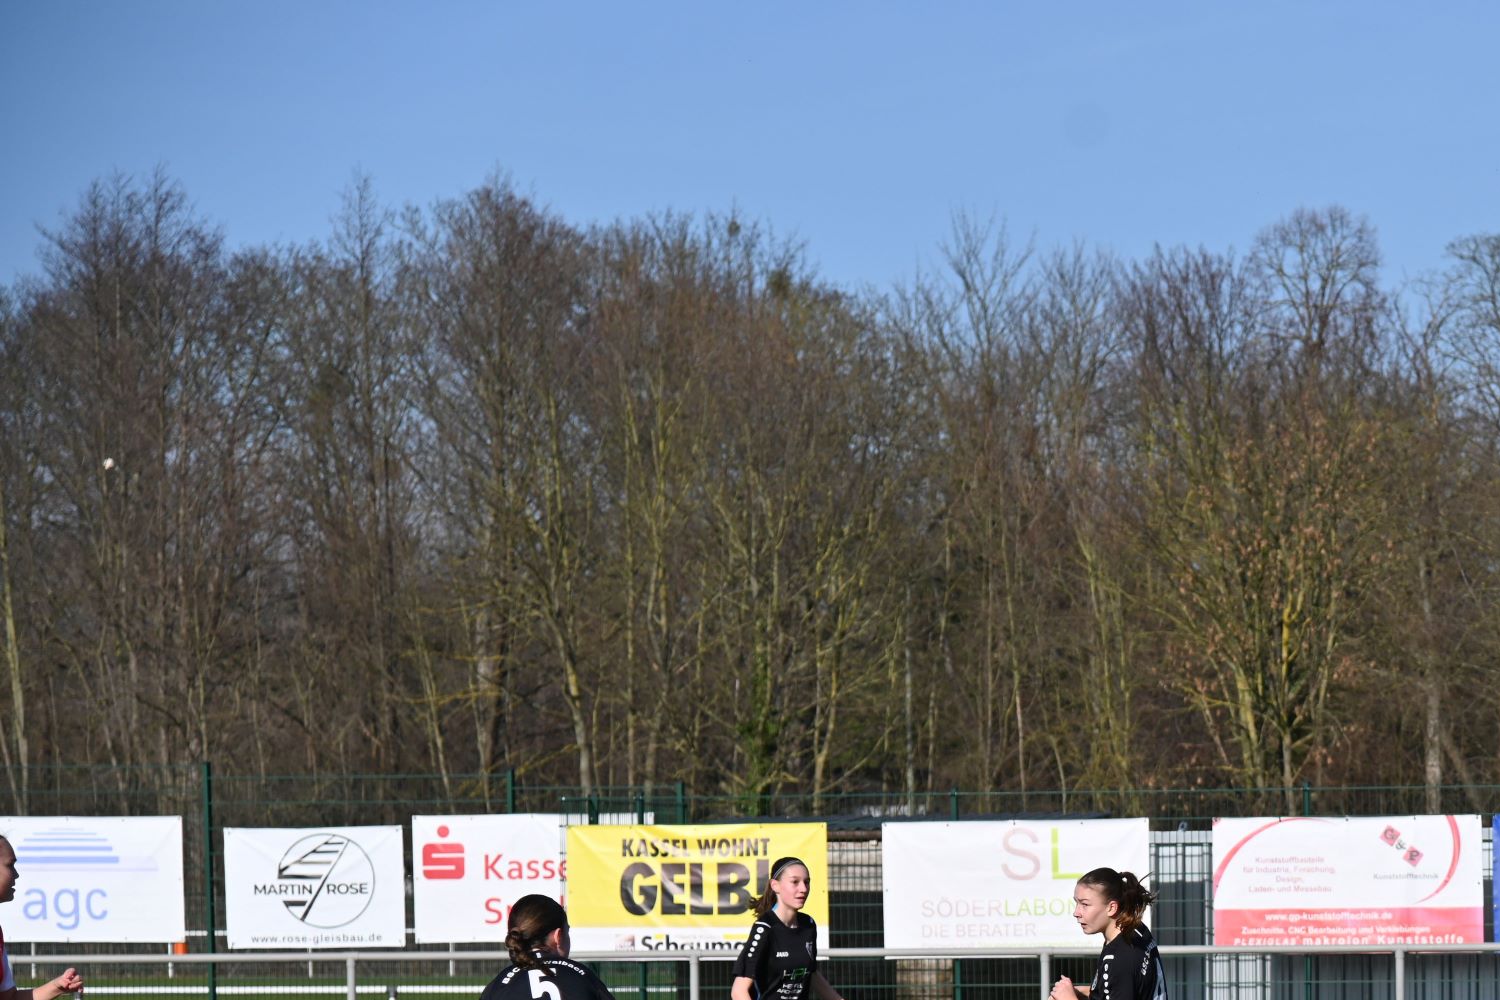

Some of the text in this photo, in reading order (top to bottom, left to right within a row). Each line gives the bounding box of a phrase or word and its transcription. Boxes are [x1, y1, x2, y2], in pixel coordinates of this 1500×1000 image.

[622, 838, 770, 857] KASSEL WOHNT
[253, 882, 369, 895] MARTIN ROSE
[23, 887, 109, 931] agc
[921, 922, 1037, 938] DIE BERATER
[250, 932, 383, 945] www.rose-gleisbau.de
